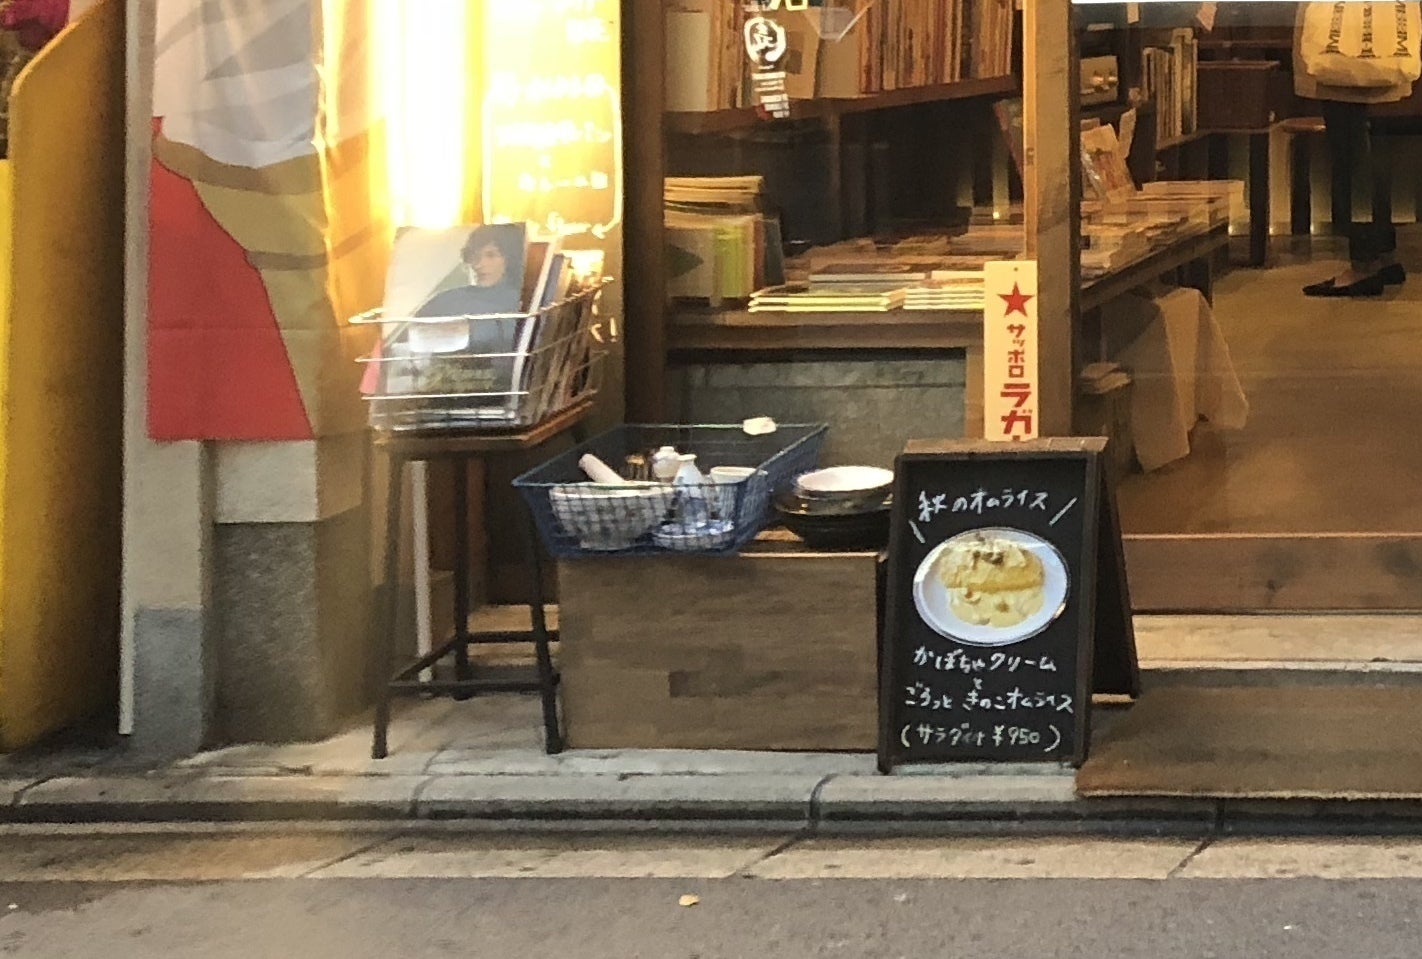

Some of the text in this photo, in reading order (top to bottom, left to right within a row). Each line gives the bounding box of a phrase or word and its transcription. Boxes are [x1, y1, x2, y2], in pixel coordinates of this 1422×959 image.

[1000, 324, 1033, 440] サッポロラガ
[912, 645, 1057, 674] かぼちゃクリーム
